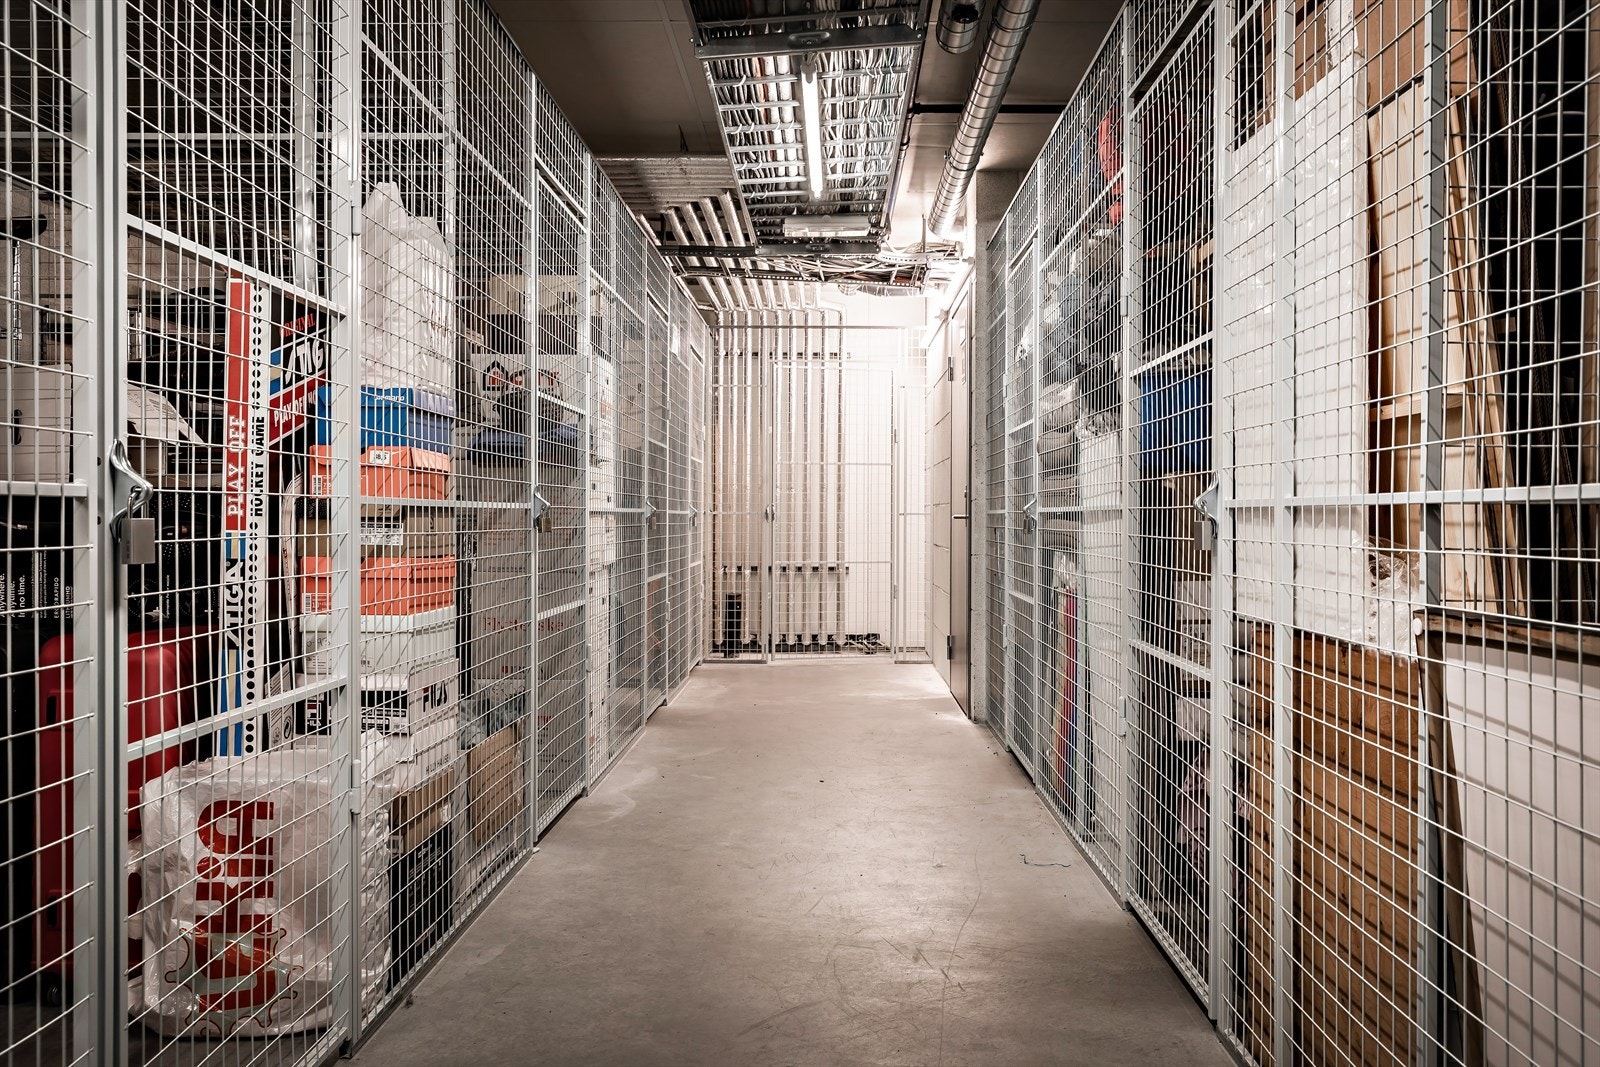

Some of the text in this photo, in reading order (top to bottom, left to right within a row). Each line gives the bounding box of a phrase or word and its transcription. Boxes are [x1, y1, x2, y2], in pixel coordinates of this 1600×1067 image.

[227, 415, 246, 517] PLAY OFF
[250, 415, 265, 517] HOCKEY GAME
[17, 574, 25, 595] time.
[422, 680, 448, 713] FILA
